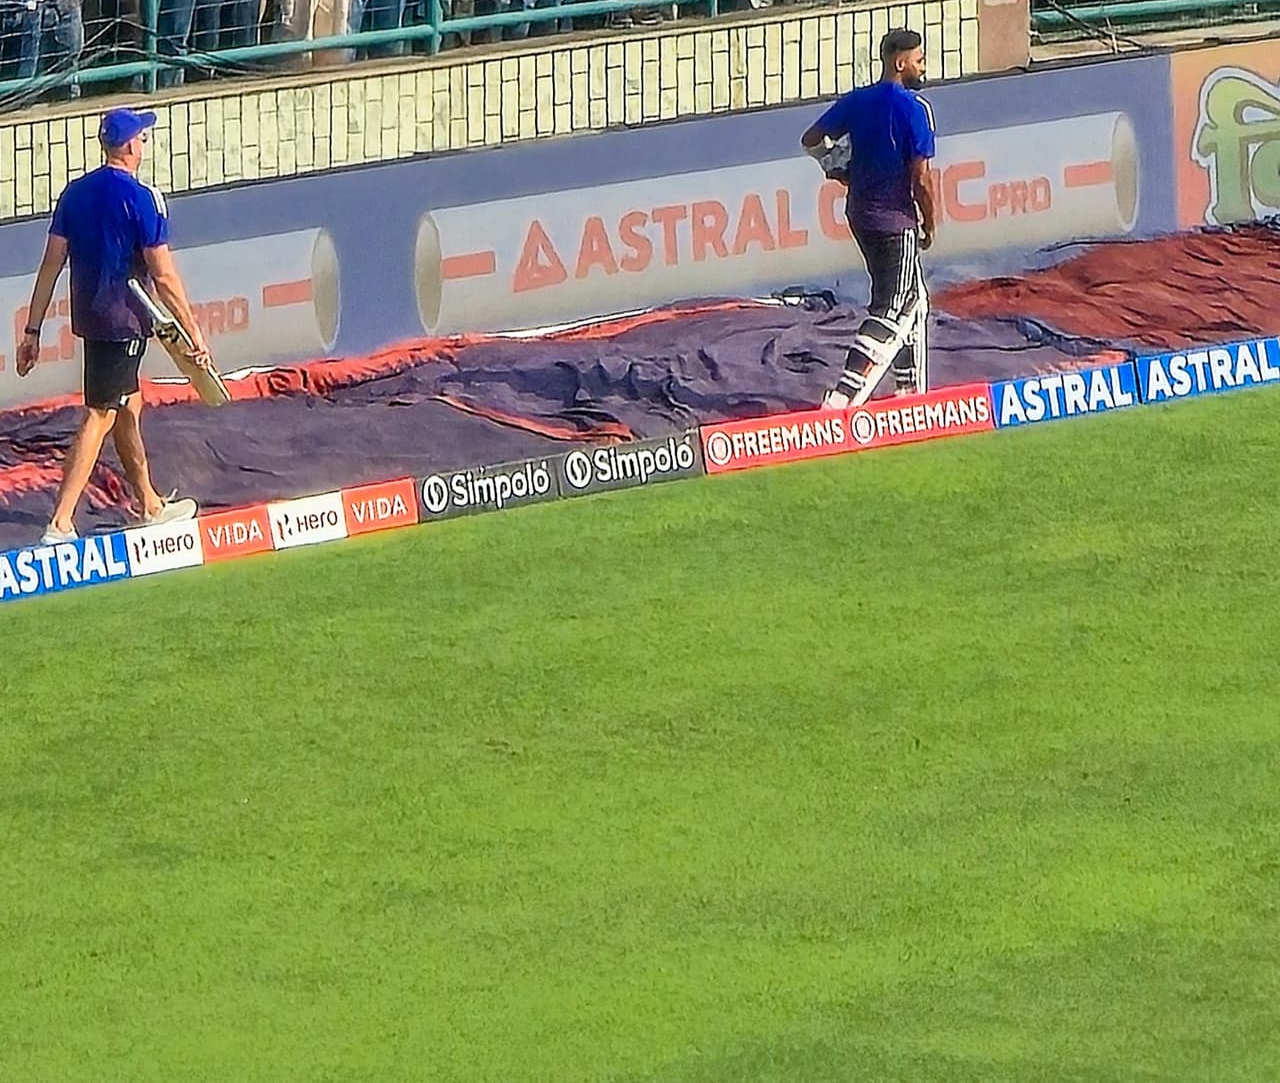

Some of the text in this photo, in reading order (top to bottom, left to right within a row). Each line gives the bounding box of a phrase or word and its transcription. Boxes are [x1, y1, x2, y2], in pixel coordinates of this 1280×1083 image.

[575, 189, 809, 279] ASTRAL
[989, 175, 1052, 217] PRO
[1001, 339, 1280, 425] ASTRAL ASTRAL
[733, 396, 990, 459] FREEMANS FREEMANS
[154, 493, 408, 557] Hero VIDA Hero VIDA
